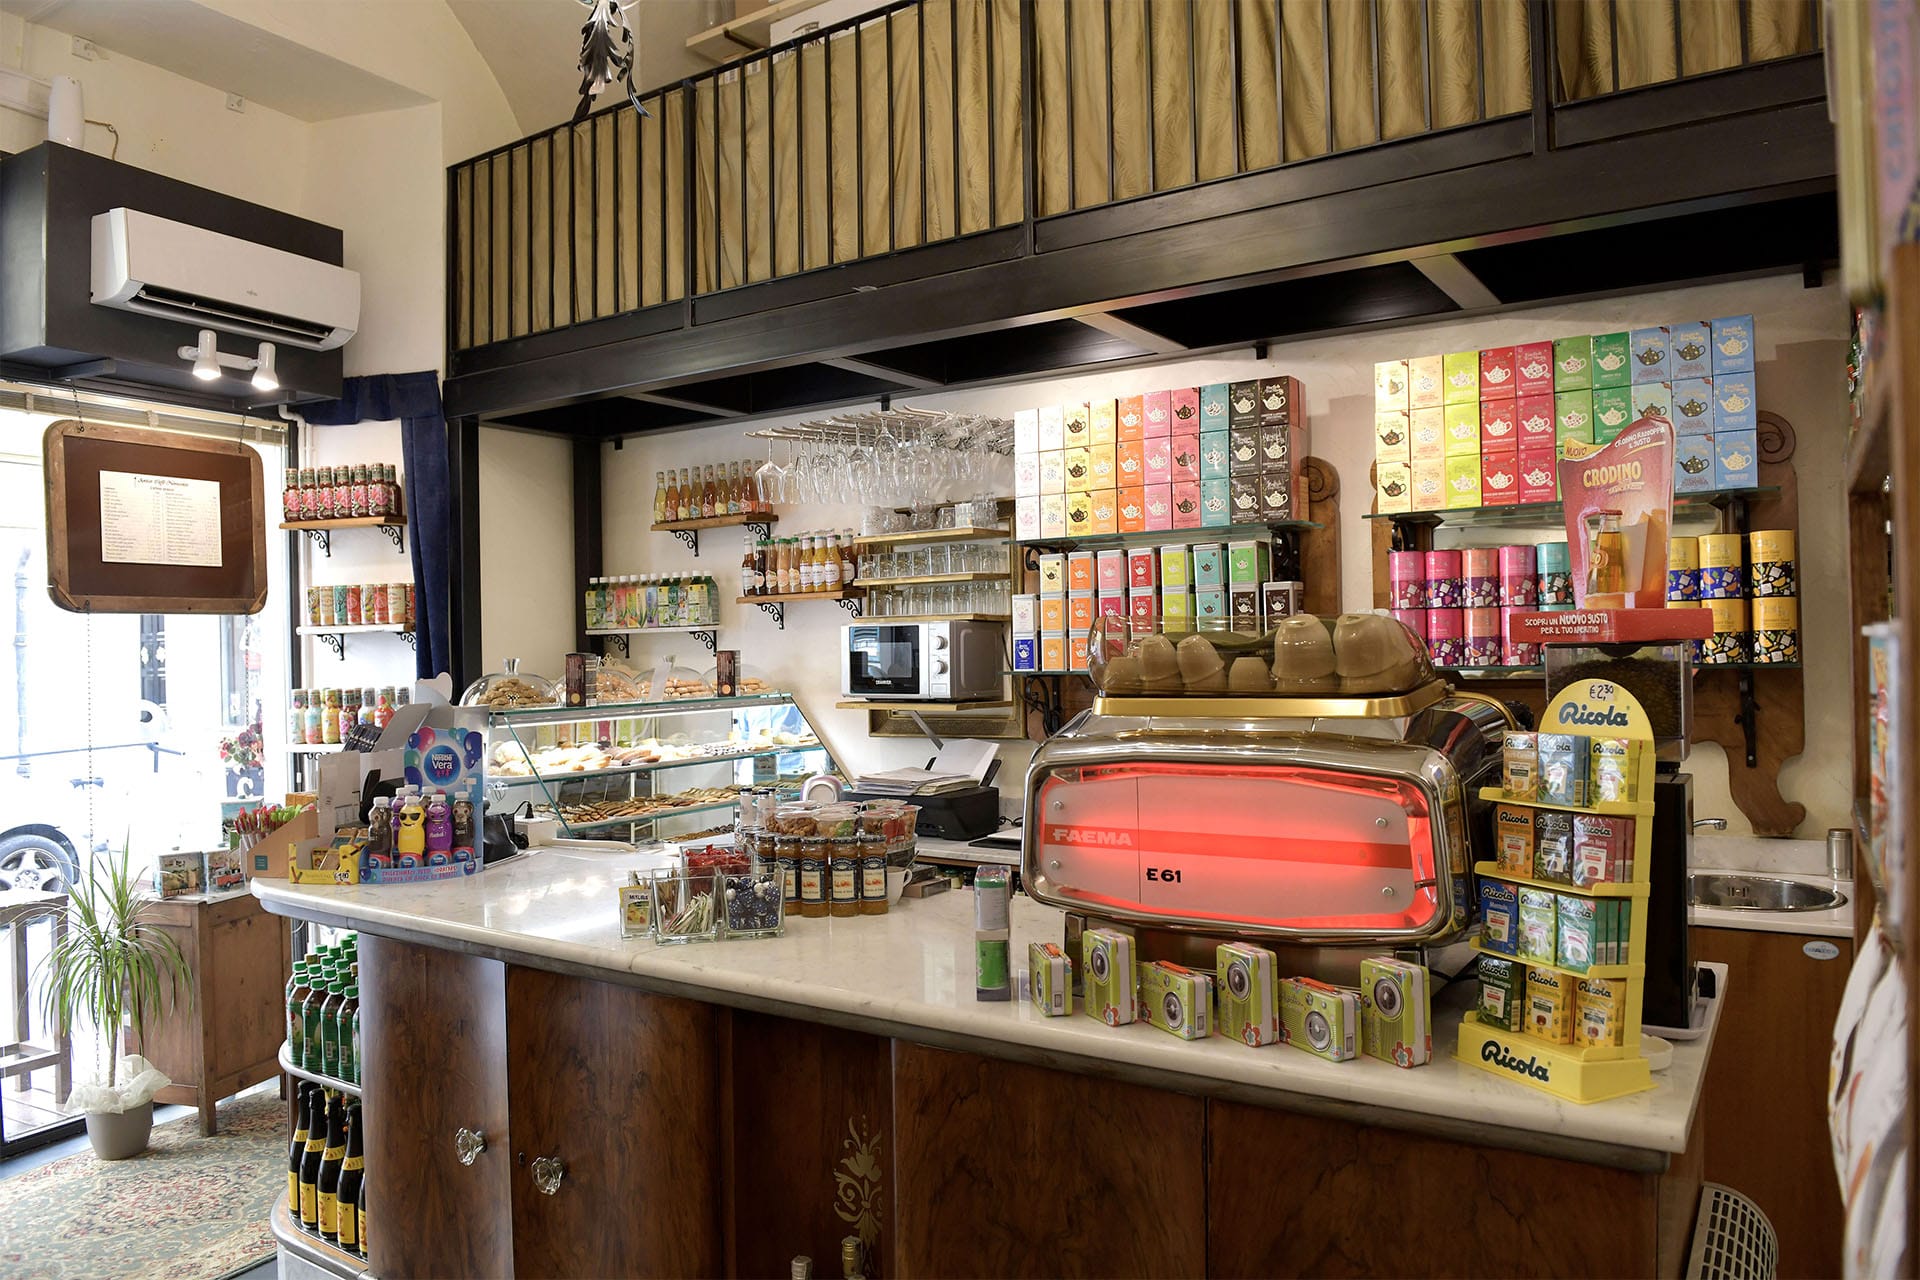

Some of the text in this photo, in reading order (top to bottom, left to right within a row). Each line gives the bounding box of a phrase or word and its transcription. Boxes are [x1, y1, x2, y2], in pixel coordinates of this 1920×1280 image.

[1565, 446, 1588, 457] NUOVO
[1583, 461, 1642, 488] CRODINO
[1525, 618, 1549, 627] SCOPRI
[1549, 618, 1559, 626] UN
[1559, 614, 1587, 625] NUOVO
[1540, 626, 1554, 635] PER
[1555, 626, 1561, 634] IL
[1561, 625, 1573, 634] TUO
[1558, 701, 1629, 727] Ricola
[432, 760, 453, 770] Vera
[1499, 811, 1530, 825] Ricola
[1536, 815, 1570, 832] Ricola
[1052, 827, 1133, 847] FAEMA
[1482, 886, 1514, 901] Ricola
[1479, 960, 1510, 978] Ricola
[1528, 971, 1560, 989] Ricola
[1578, 980, 1612, 999] Ricola
[1481, 1040, 1550, 1083] Ricola
